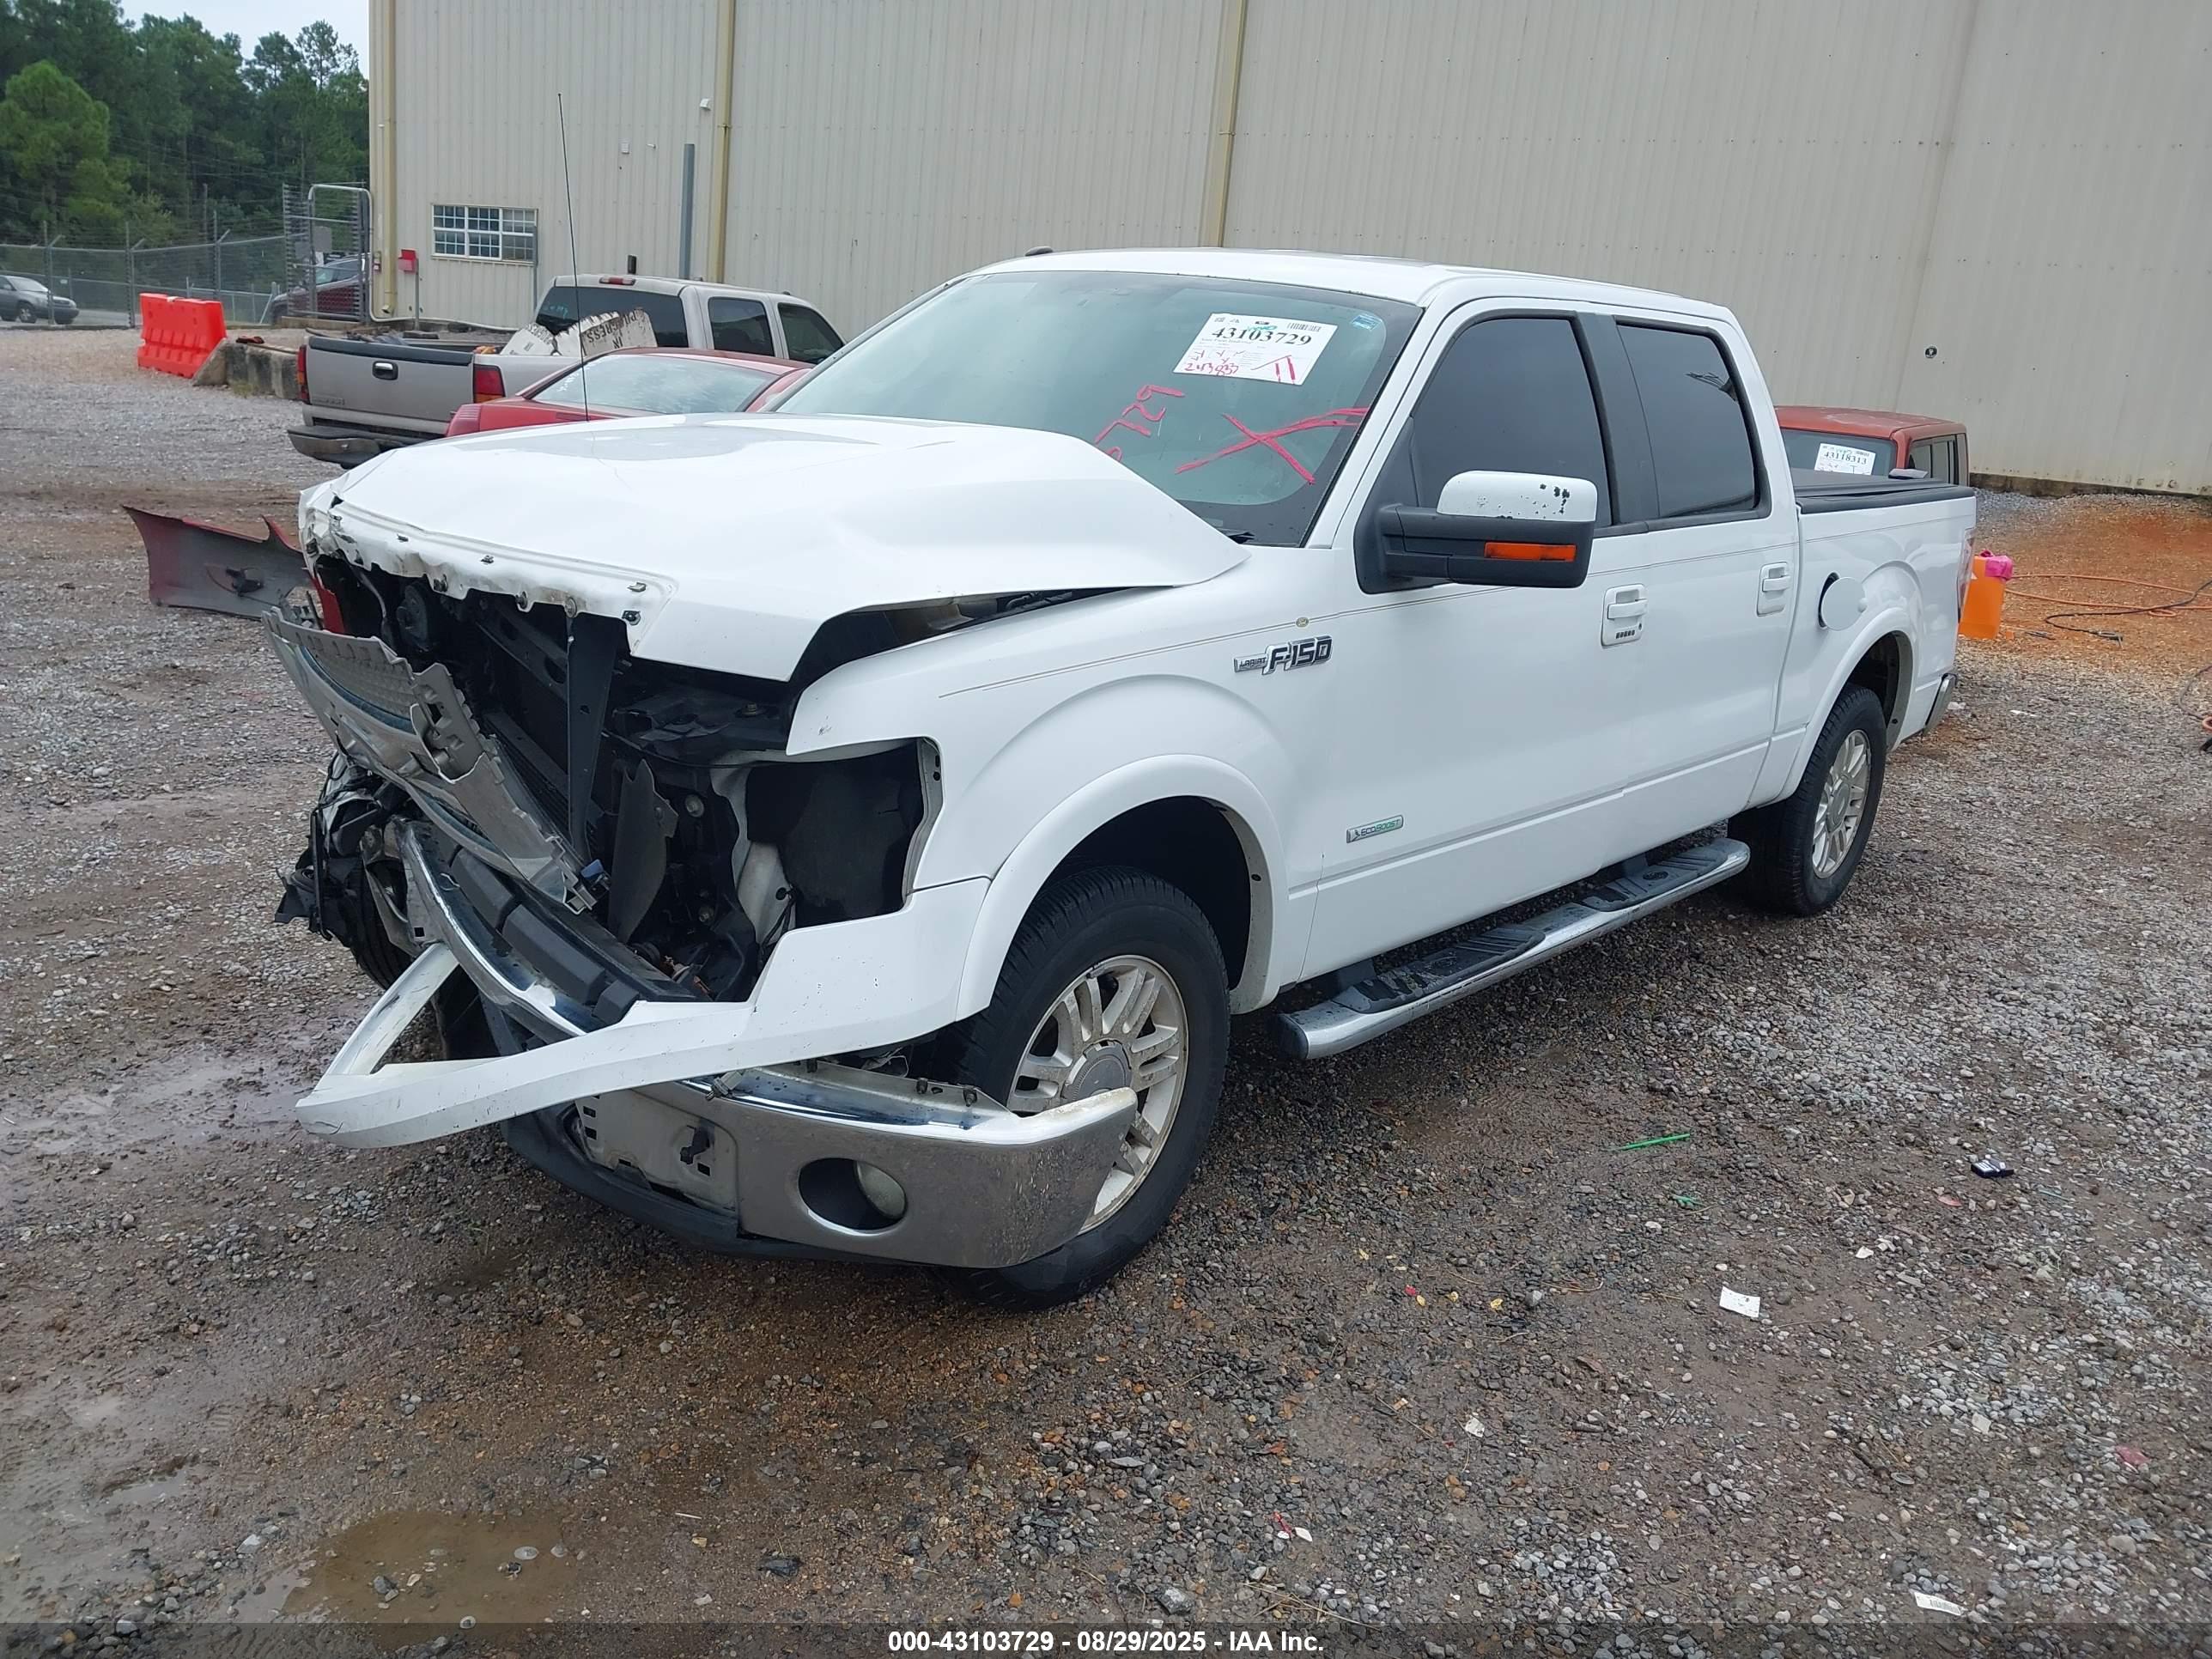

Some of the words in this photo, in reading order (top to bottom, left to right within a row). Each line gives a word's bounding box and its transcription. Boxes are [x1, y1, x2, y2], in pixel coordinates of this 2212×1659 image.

[1212, 326, 1312, 346] 43103729
[1824, 451, 1867, 465] 43118313
[1239, 655, 1267, 668] LARIAT
[1266, 636, 1333, 673] F-150
